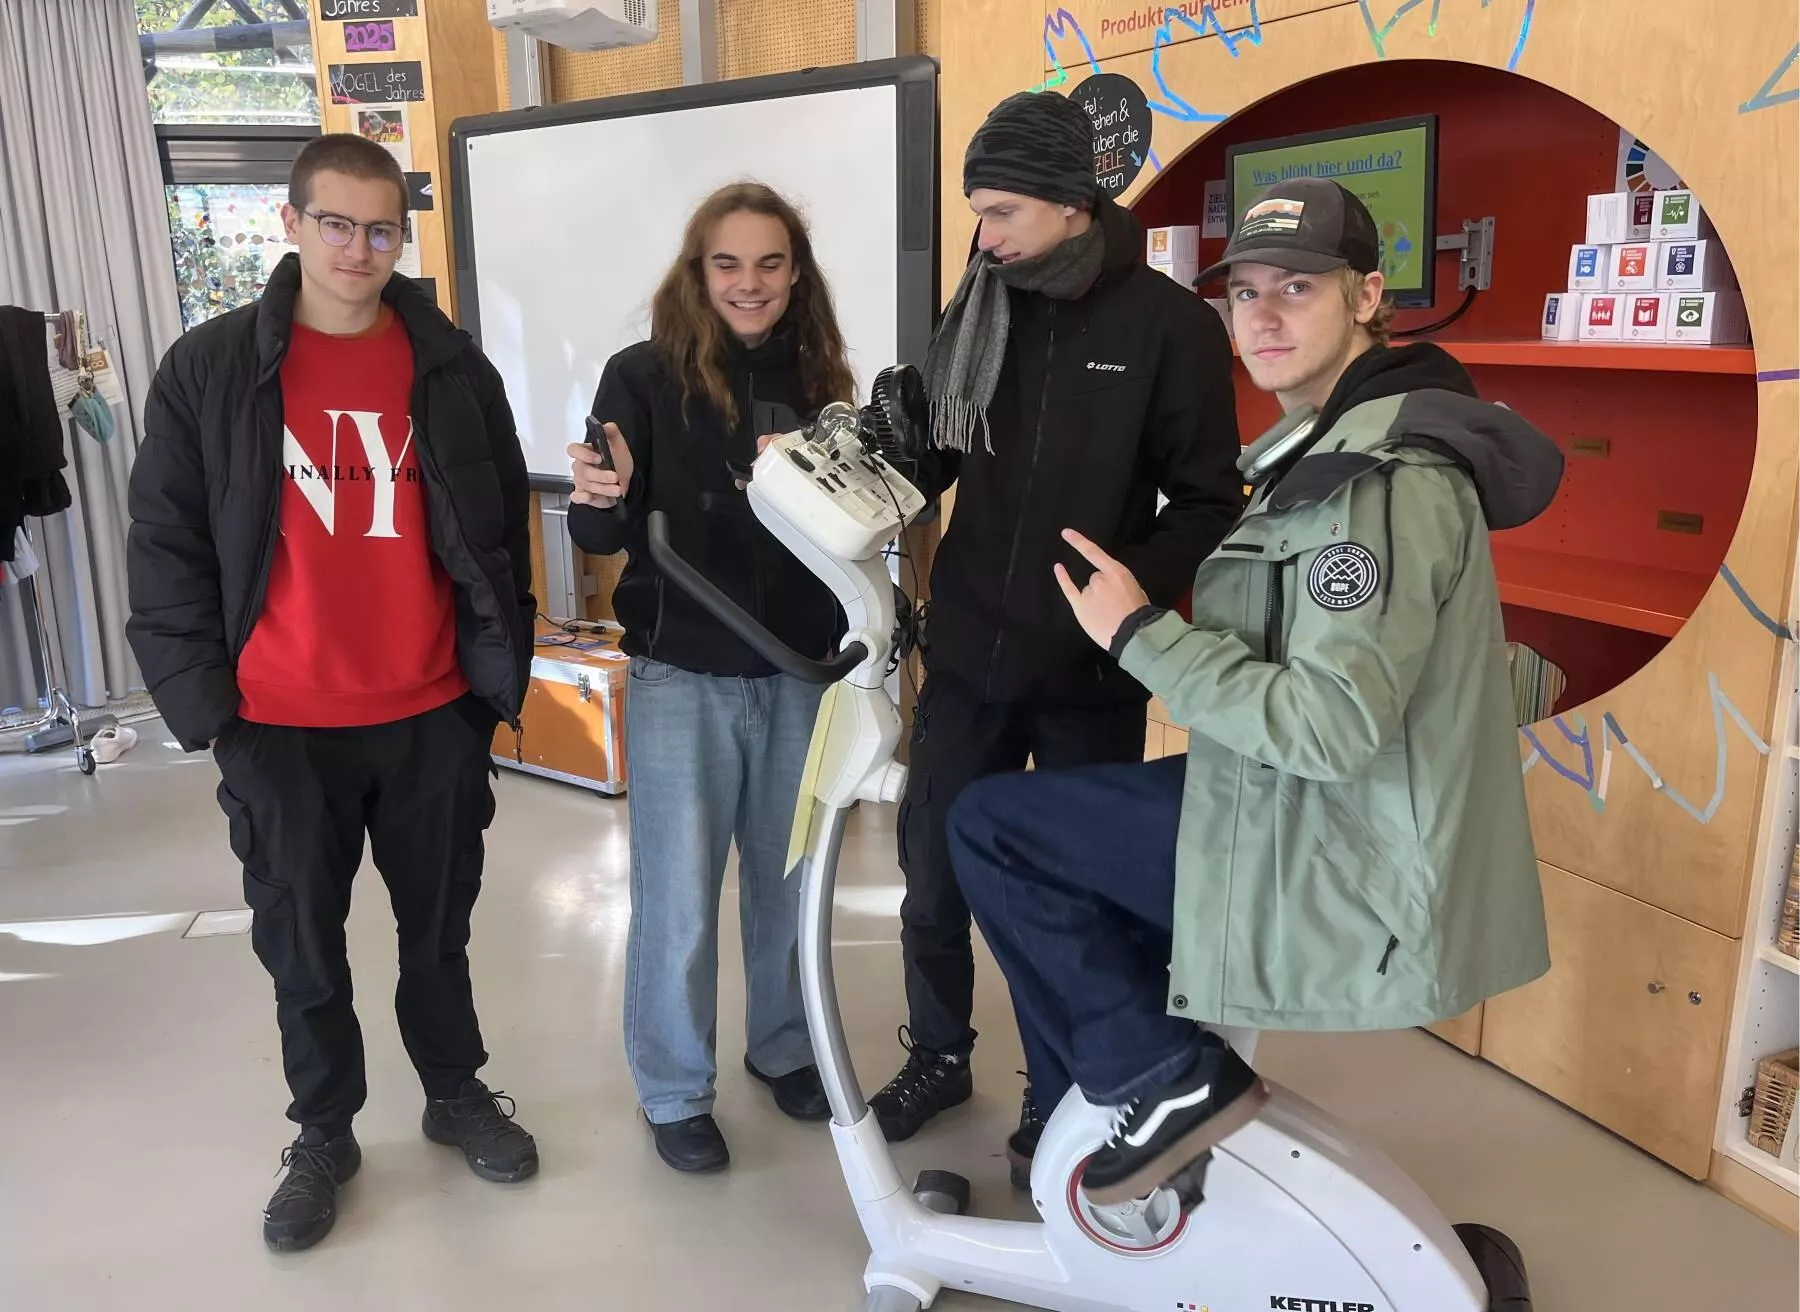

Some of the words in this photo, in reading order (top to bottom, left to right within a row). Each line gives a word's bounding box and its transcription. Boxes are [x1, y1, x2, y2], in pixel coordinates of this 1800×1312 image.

[325, 0, 381, 17] Jahres
[1101, 6, 1172, 39] Produkt
[345, 23, 394, 51] 2025
[331, 70, 383, 94] VOGEL
[386, 67, 406, 83] des
[385, 84, 424, 101] Jahres
[1083, 97, 1097, 115] fel
[1120, 97, 1130, 122] &
[1093, 133, 1120, 154] über
[1122, 125, 1139, 146] die
[1094, 147, 1126, 176] ZIELE
[1377, 150, 1402, 169] da?
[1096, 172, 1125, 189] hren
[1095, 363, 1127, 372] LOTTO
[282, 464, 375, 482] INALLY
[282, 410, 414, 537] NY
[1270, 1296, 1374, 1312] KETTLER
